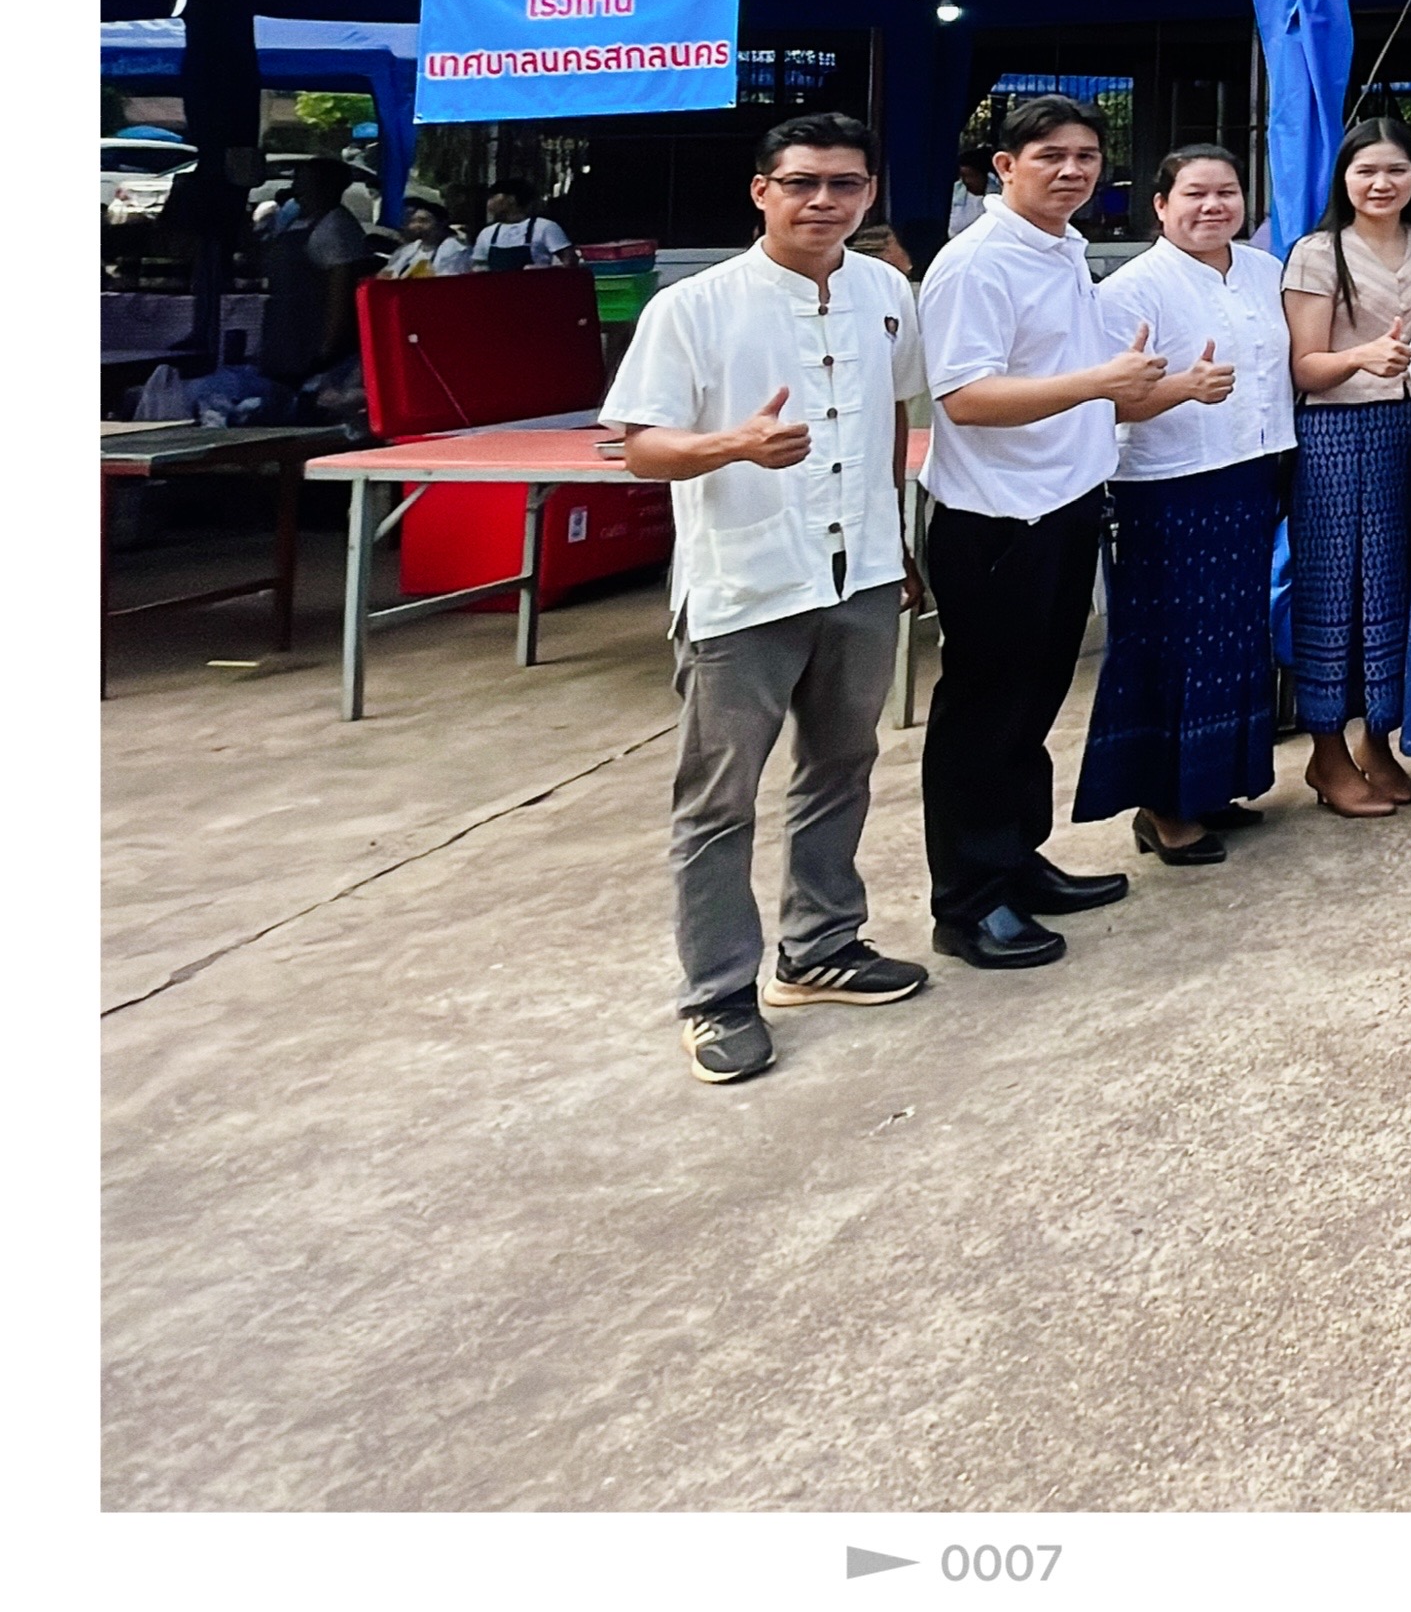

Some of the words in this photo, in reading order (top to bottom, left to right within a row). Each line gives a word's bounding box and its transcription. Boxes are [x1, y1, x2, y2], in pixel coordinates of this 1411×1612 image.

[425, 39, 731, 80] เทศบาลนครสกลนคร
